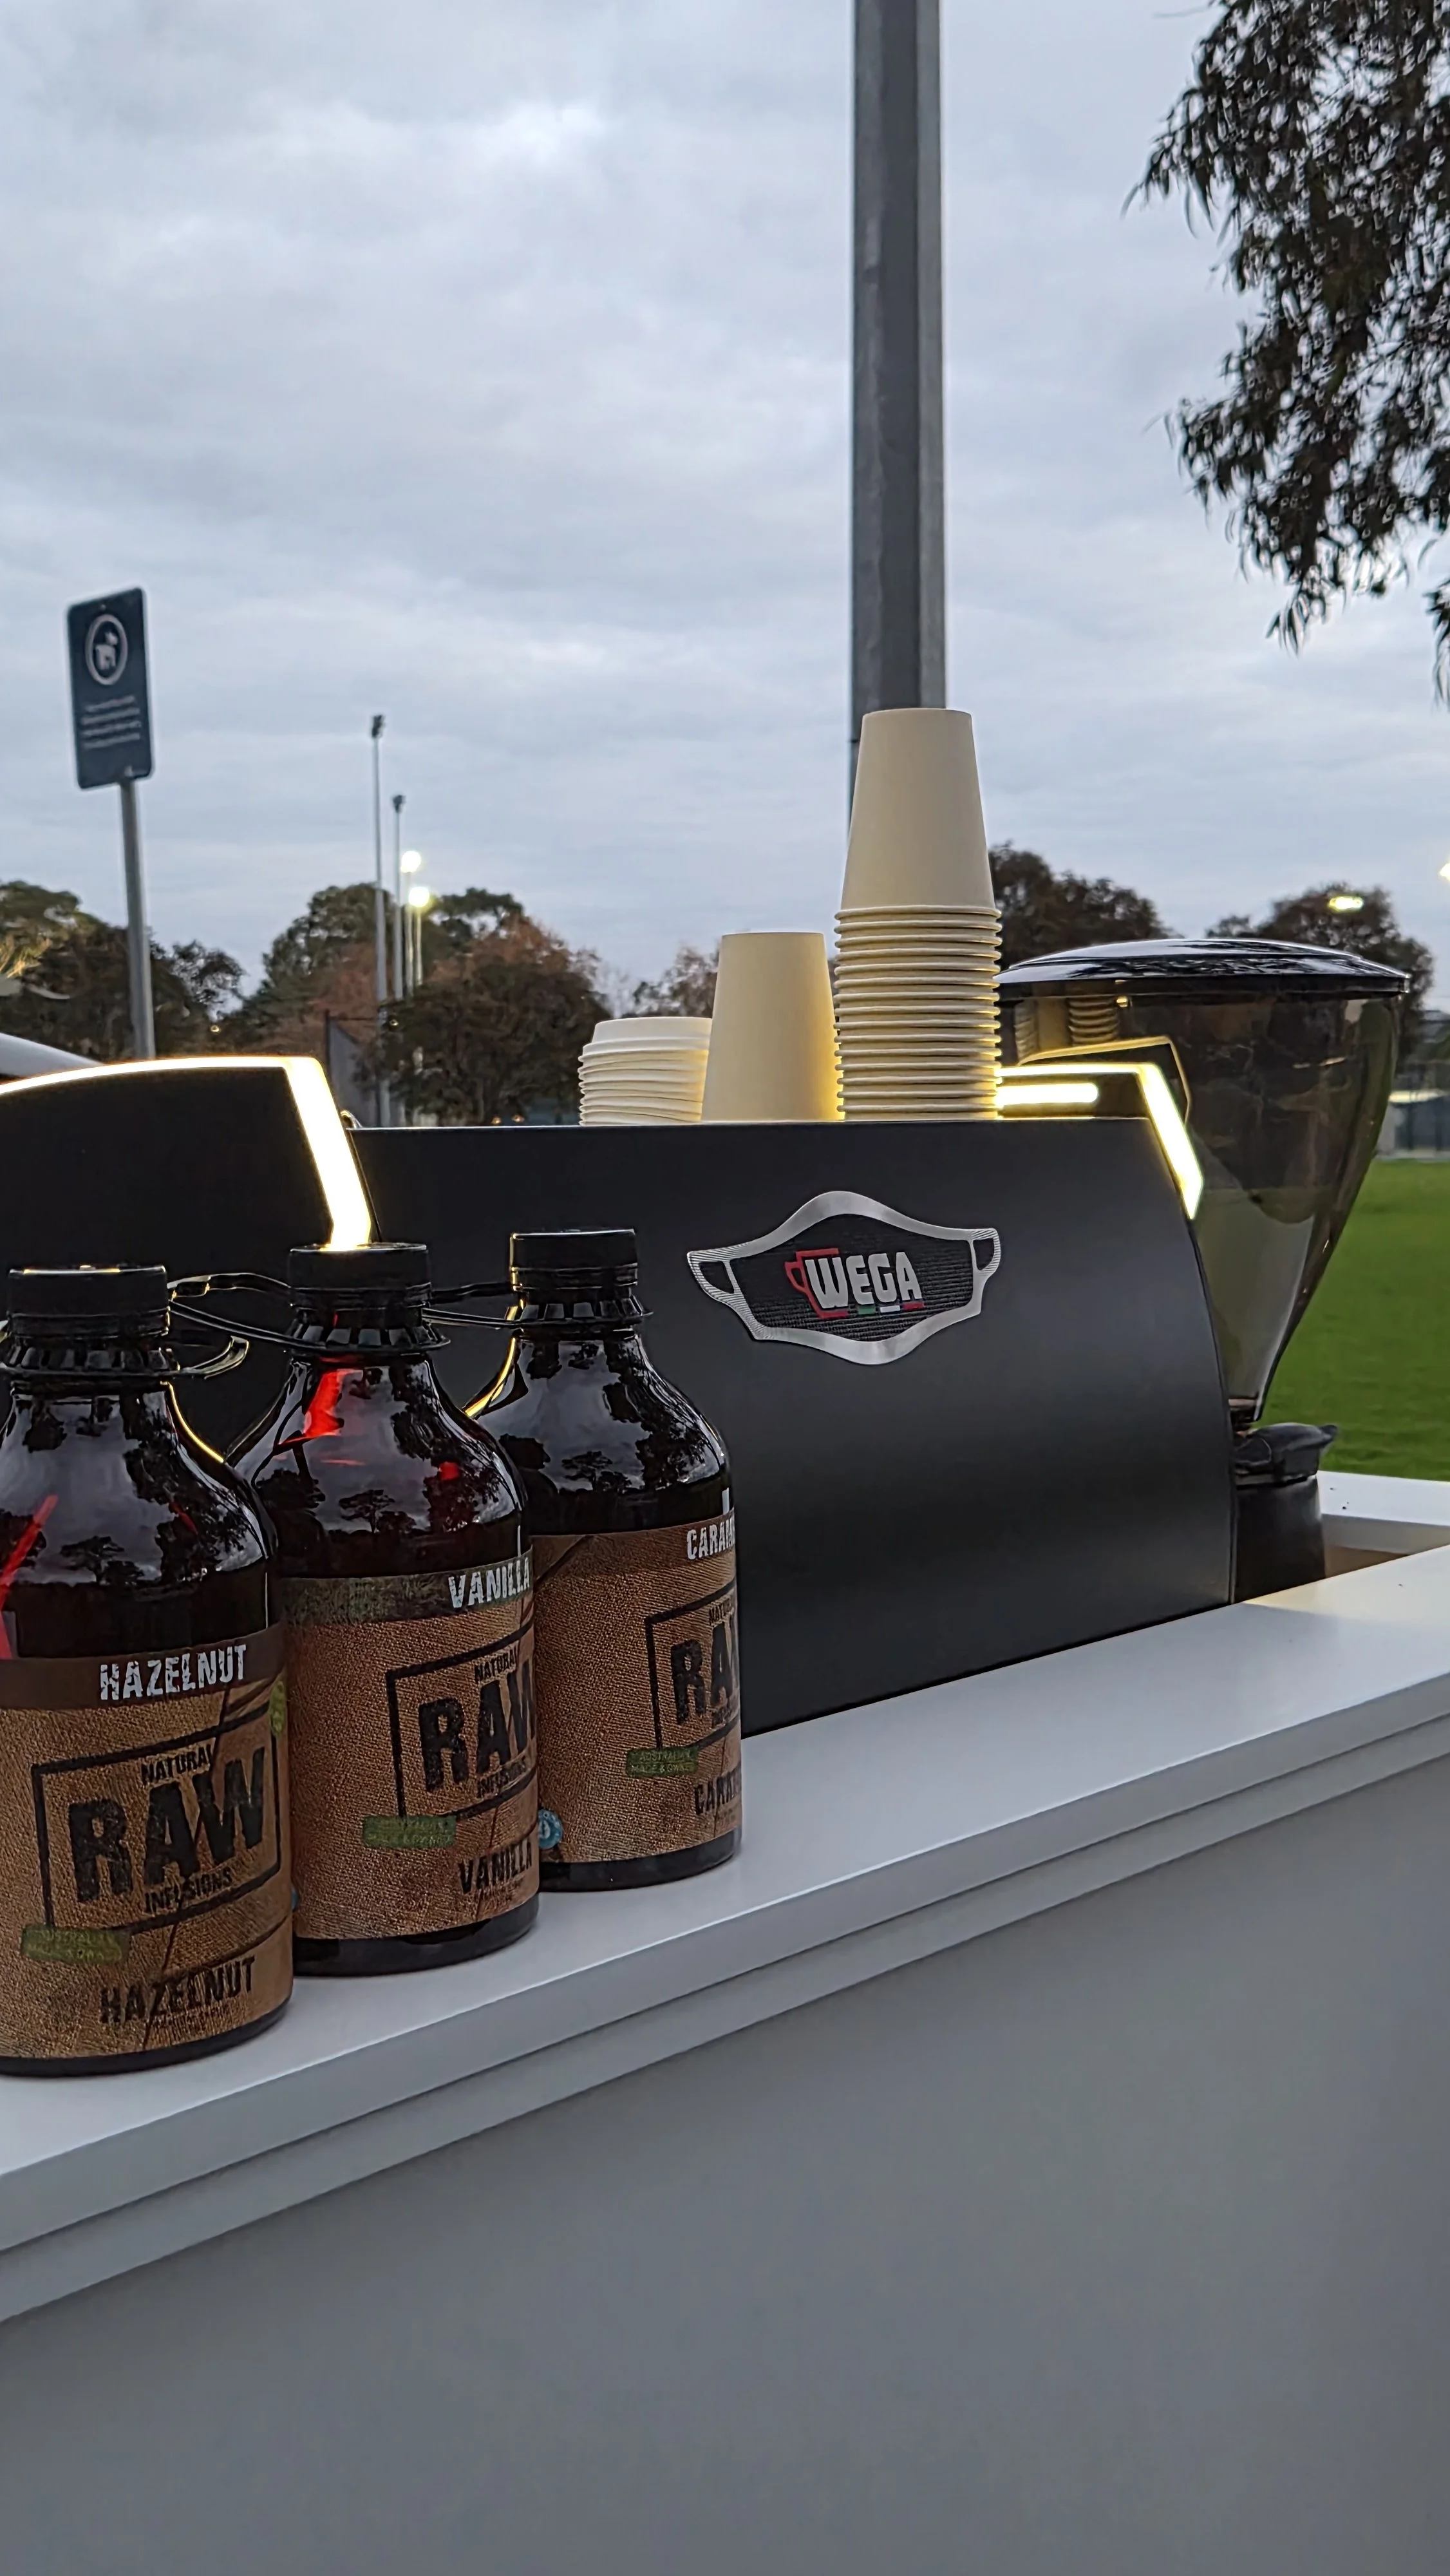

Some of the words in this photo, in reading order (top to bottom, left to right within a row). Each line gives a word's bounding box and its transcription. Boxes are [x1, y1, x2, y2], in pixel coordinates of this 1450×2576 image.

[804, 1251, 923, 1309] WEGA
[686, 1515, 735, 1560] CARAM
[448, 1557, 530, 1608] VANILLA
[100, 1644, 247, 1700] HAZELNUT
[69, 1747, 265, 1902] RAW
[459, 1839, 532, 1894] VANILLA
[101, 1955, 255, 2023] HAZELNUT
